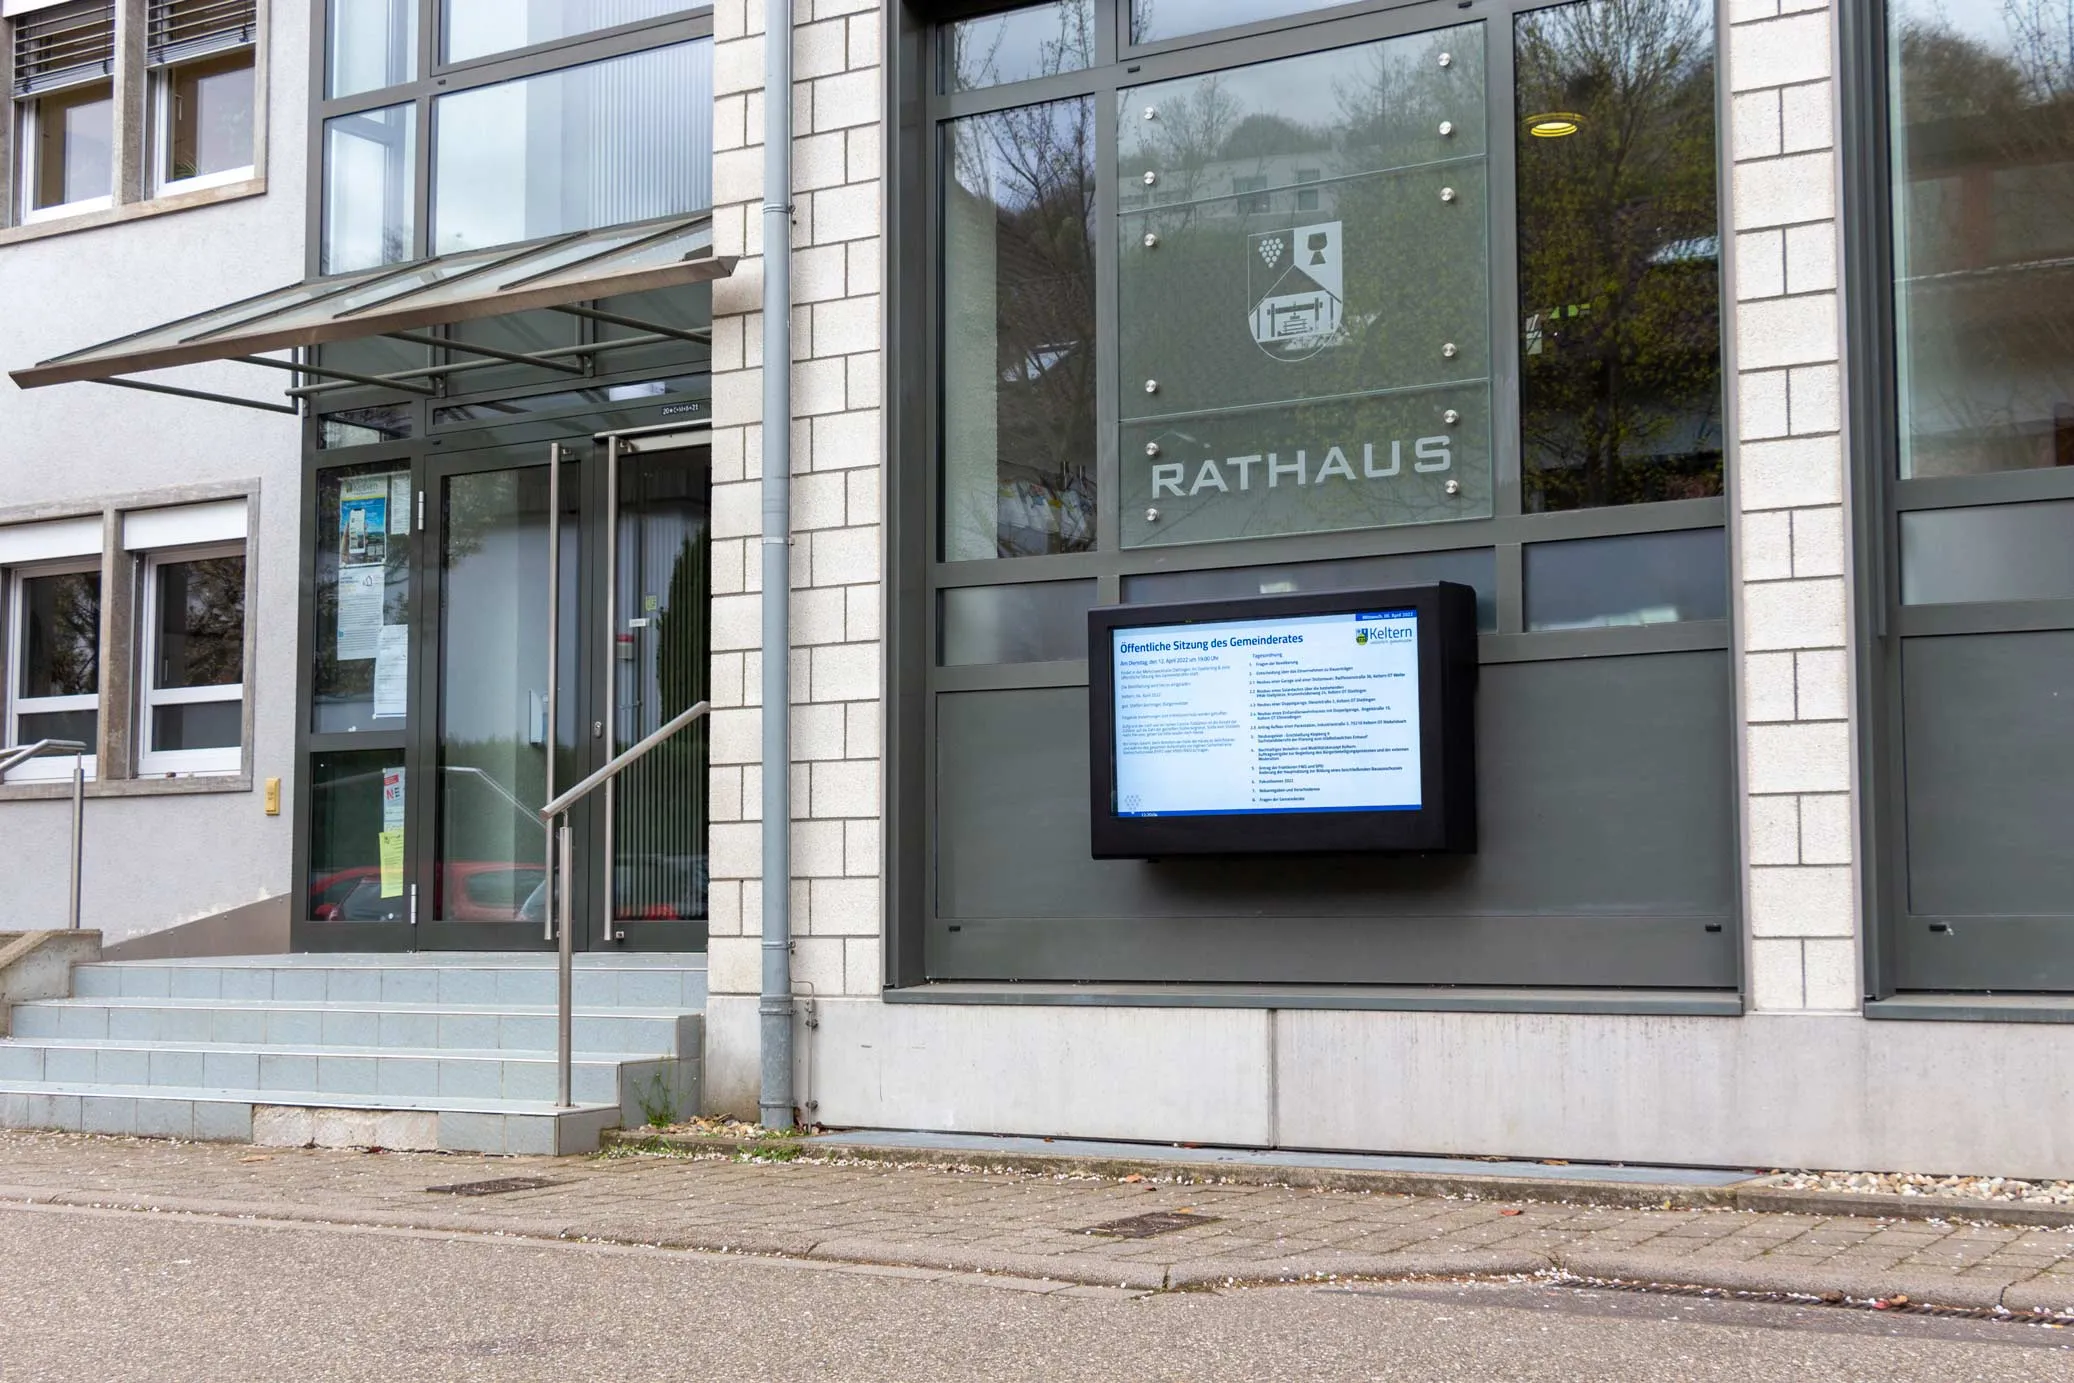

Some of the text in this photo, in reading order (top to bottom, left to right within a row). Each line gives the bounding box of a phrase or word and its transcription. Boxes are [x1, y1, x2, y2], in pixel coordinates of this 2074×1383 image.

[1152, 435, 1451, 499] RATHAUS
[1120, 633, 1304, 654] Öffentliche Sitzung des Gemeinderates
[1369, 626, 1413, 640] Keltern
